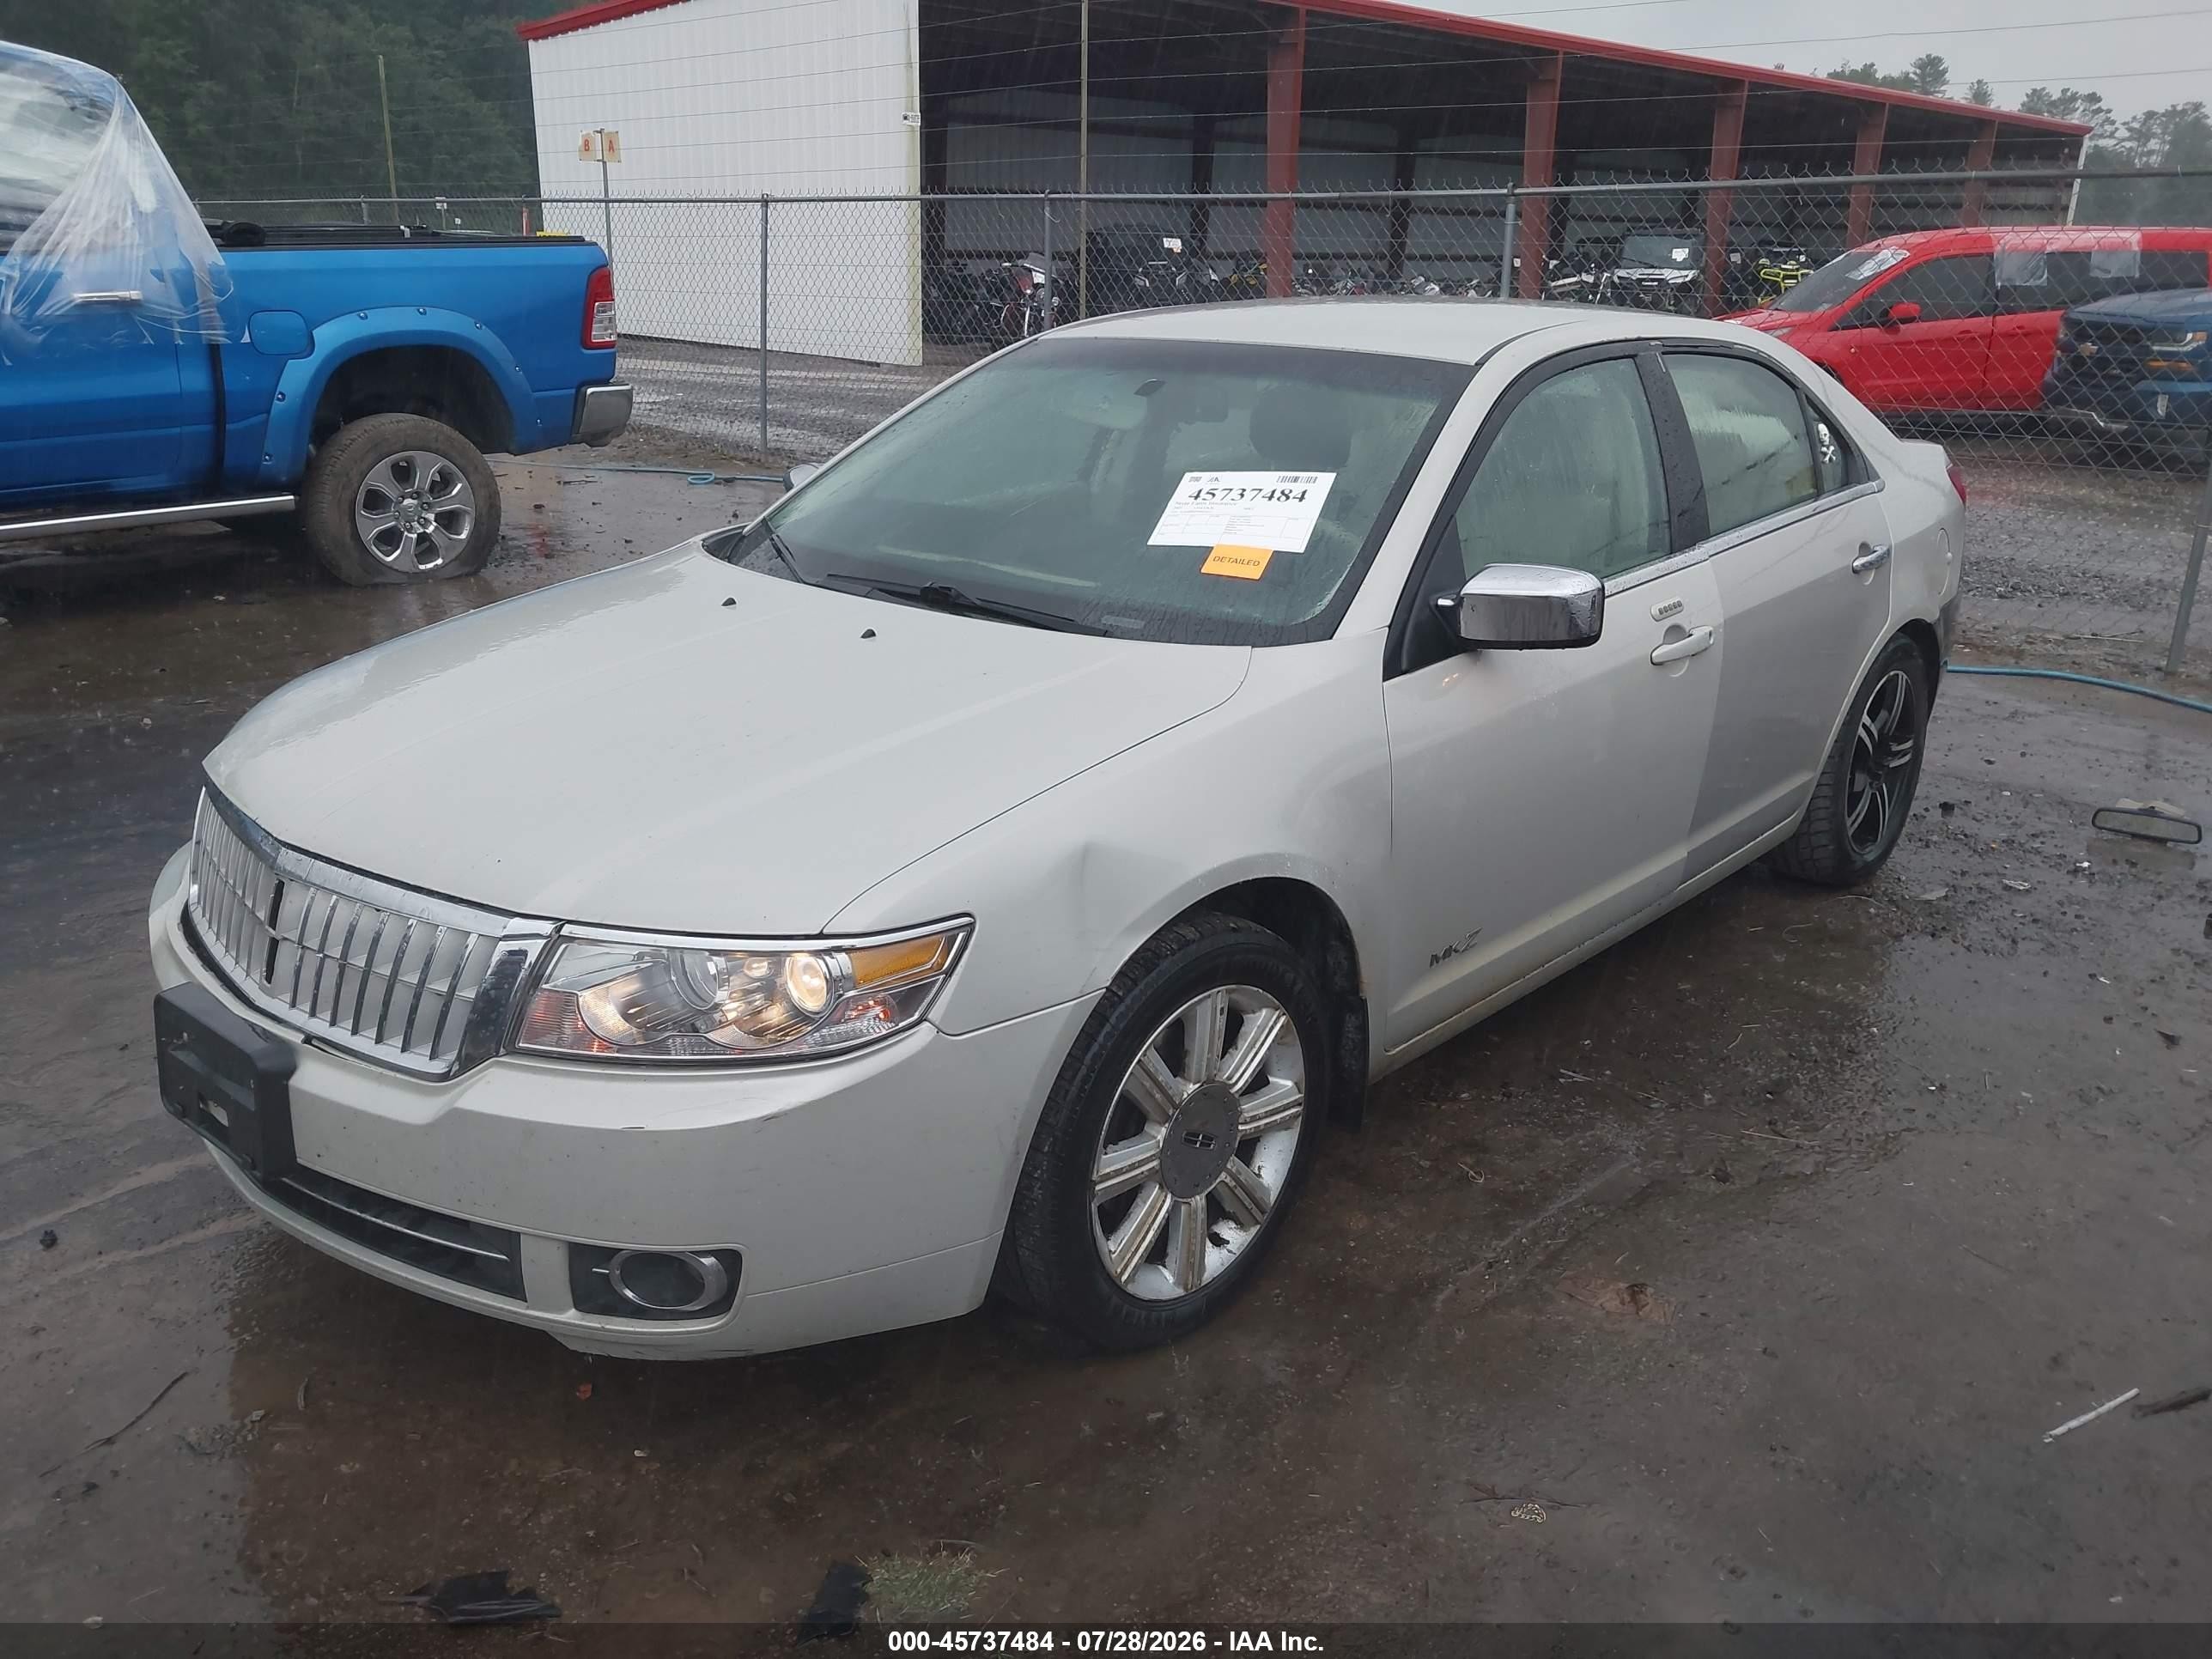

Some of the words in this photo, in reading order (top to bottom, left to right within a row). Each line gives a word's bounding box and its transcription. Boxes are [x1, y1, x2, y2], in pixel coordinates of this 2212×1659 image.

[584, 139, 590, 151] B
[608, 139, 615, 152] A
[1188, 488, 1308, 502] 45737484
[1212, 555, 1261, 567] DETAILED
